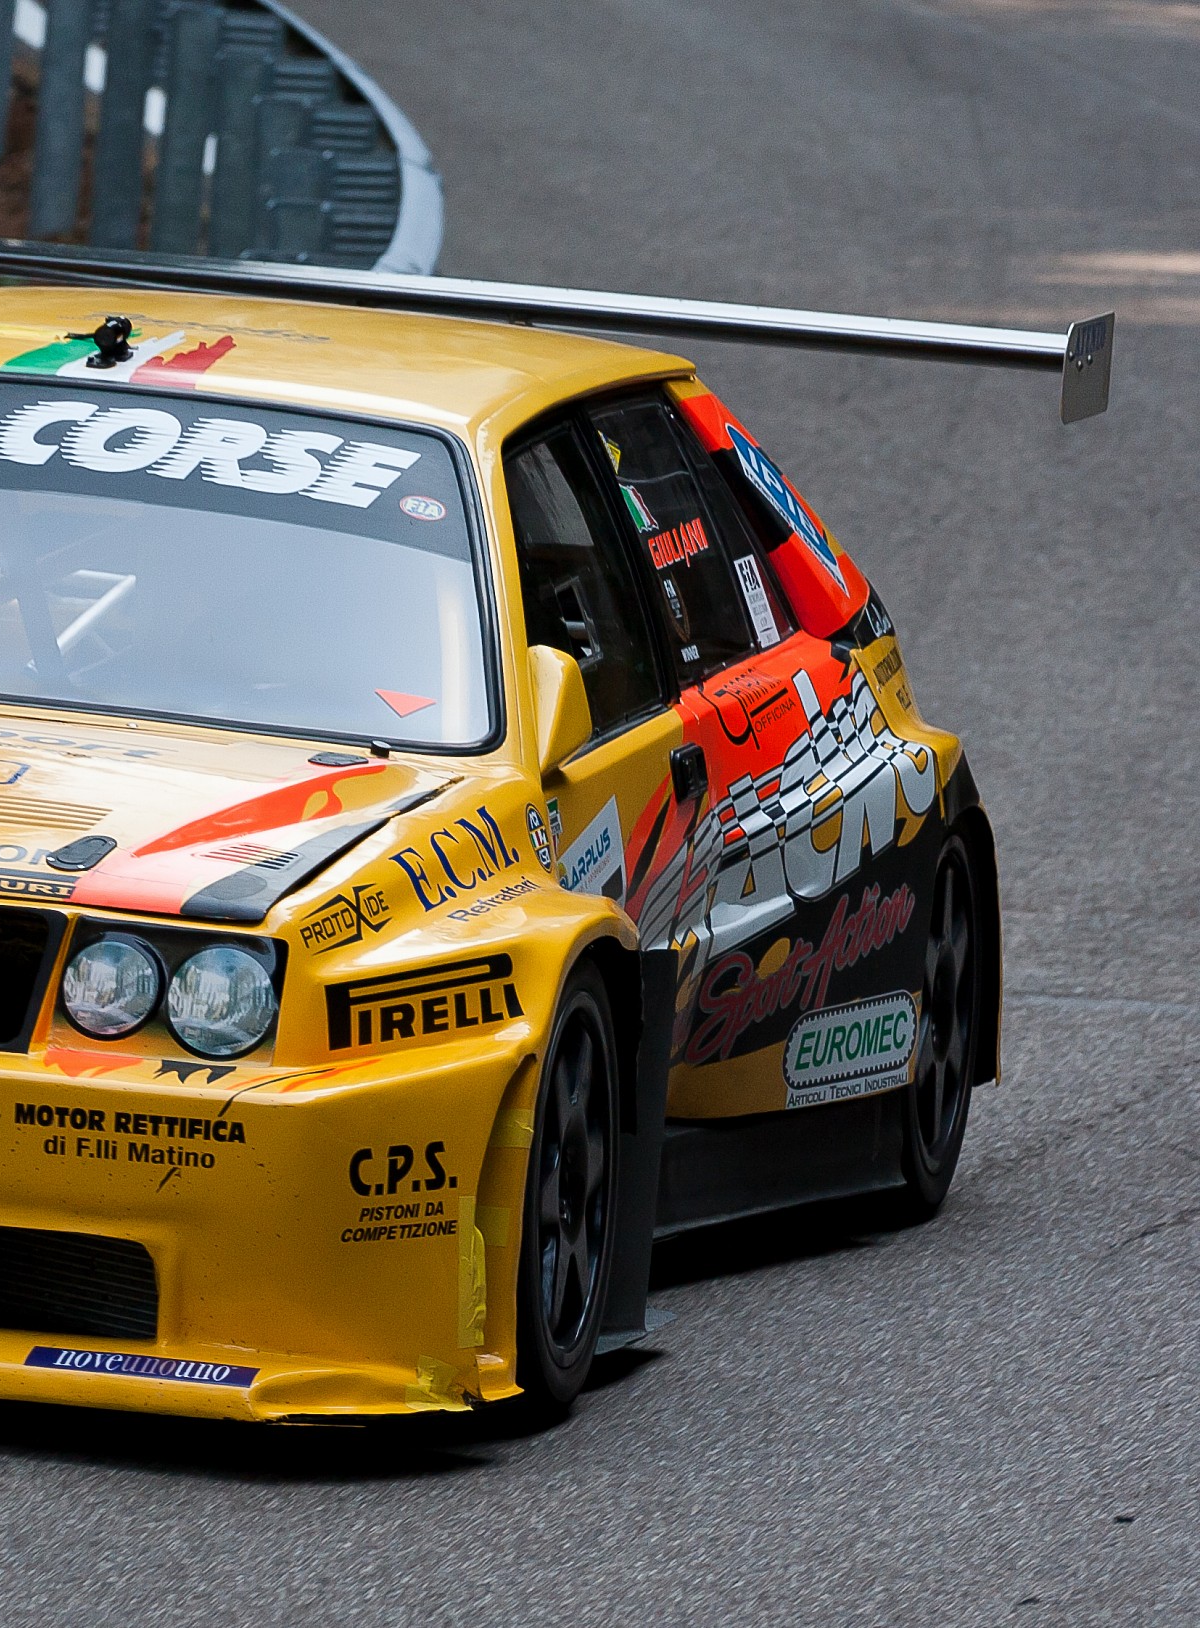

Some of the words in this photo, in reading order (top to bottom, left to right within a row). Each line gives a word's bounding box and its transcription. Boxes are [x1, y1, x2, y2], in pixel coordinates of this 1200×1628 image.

[648, 517, 709, 570] GIULIANI
[737, 559, 761, 593] FIA
[754, 698, 796, 733] OFFICINA
[389, 806, 520, 912] E.C.M.
[448, 876, 542, 922] Refrattari
[800, 883, 915, 1009] Action
[324, 953, 525, 1051] PIRELLI
[794, 1010, 908, 1071] EUROMEC
[787, 1090, 826, 1108] ARTICOLI
[830, 1084, 861, 1100] TECNICI
[864, 1072, 908, 1093] INDUSTRIALI
[14, 1102, 105, 1132] MOTOR
[114, 1112, 246, 1144] RETTIFICA
[43, 1135, 66, 1156] di
[128, 1141, 216, 1169] Matino
[349, 1141, 458, 1197] C.P.S.
[341, 1220, 458, 1243] COMPETIZIONE
[359, 1202, 421, 1223] PISTONI
[424, 1201, 444, 1217] DA
[52, 1349, 232, 1382] noveunouno
